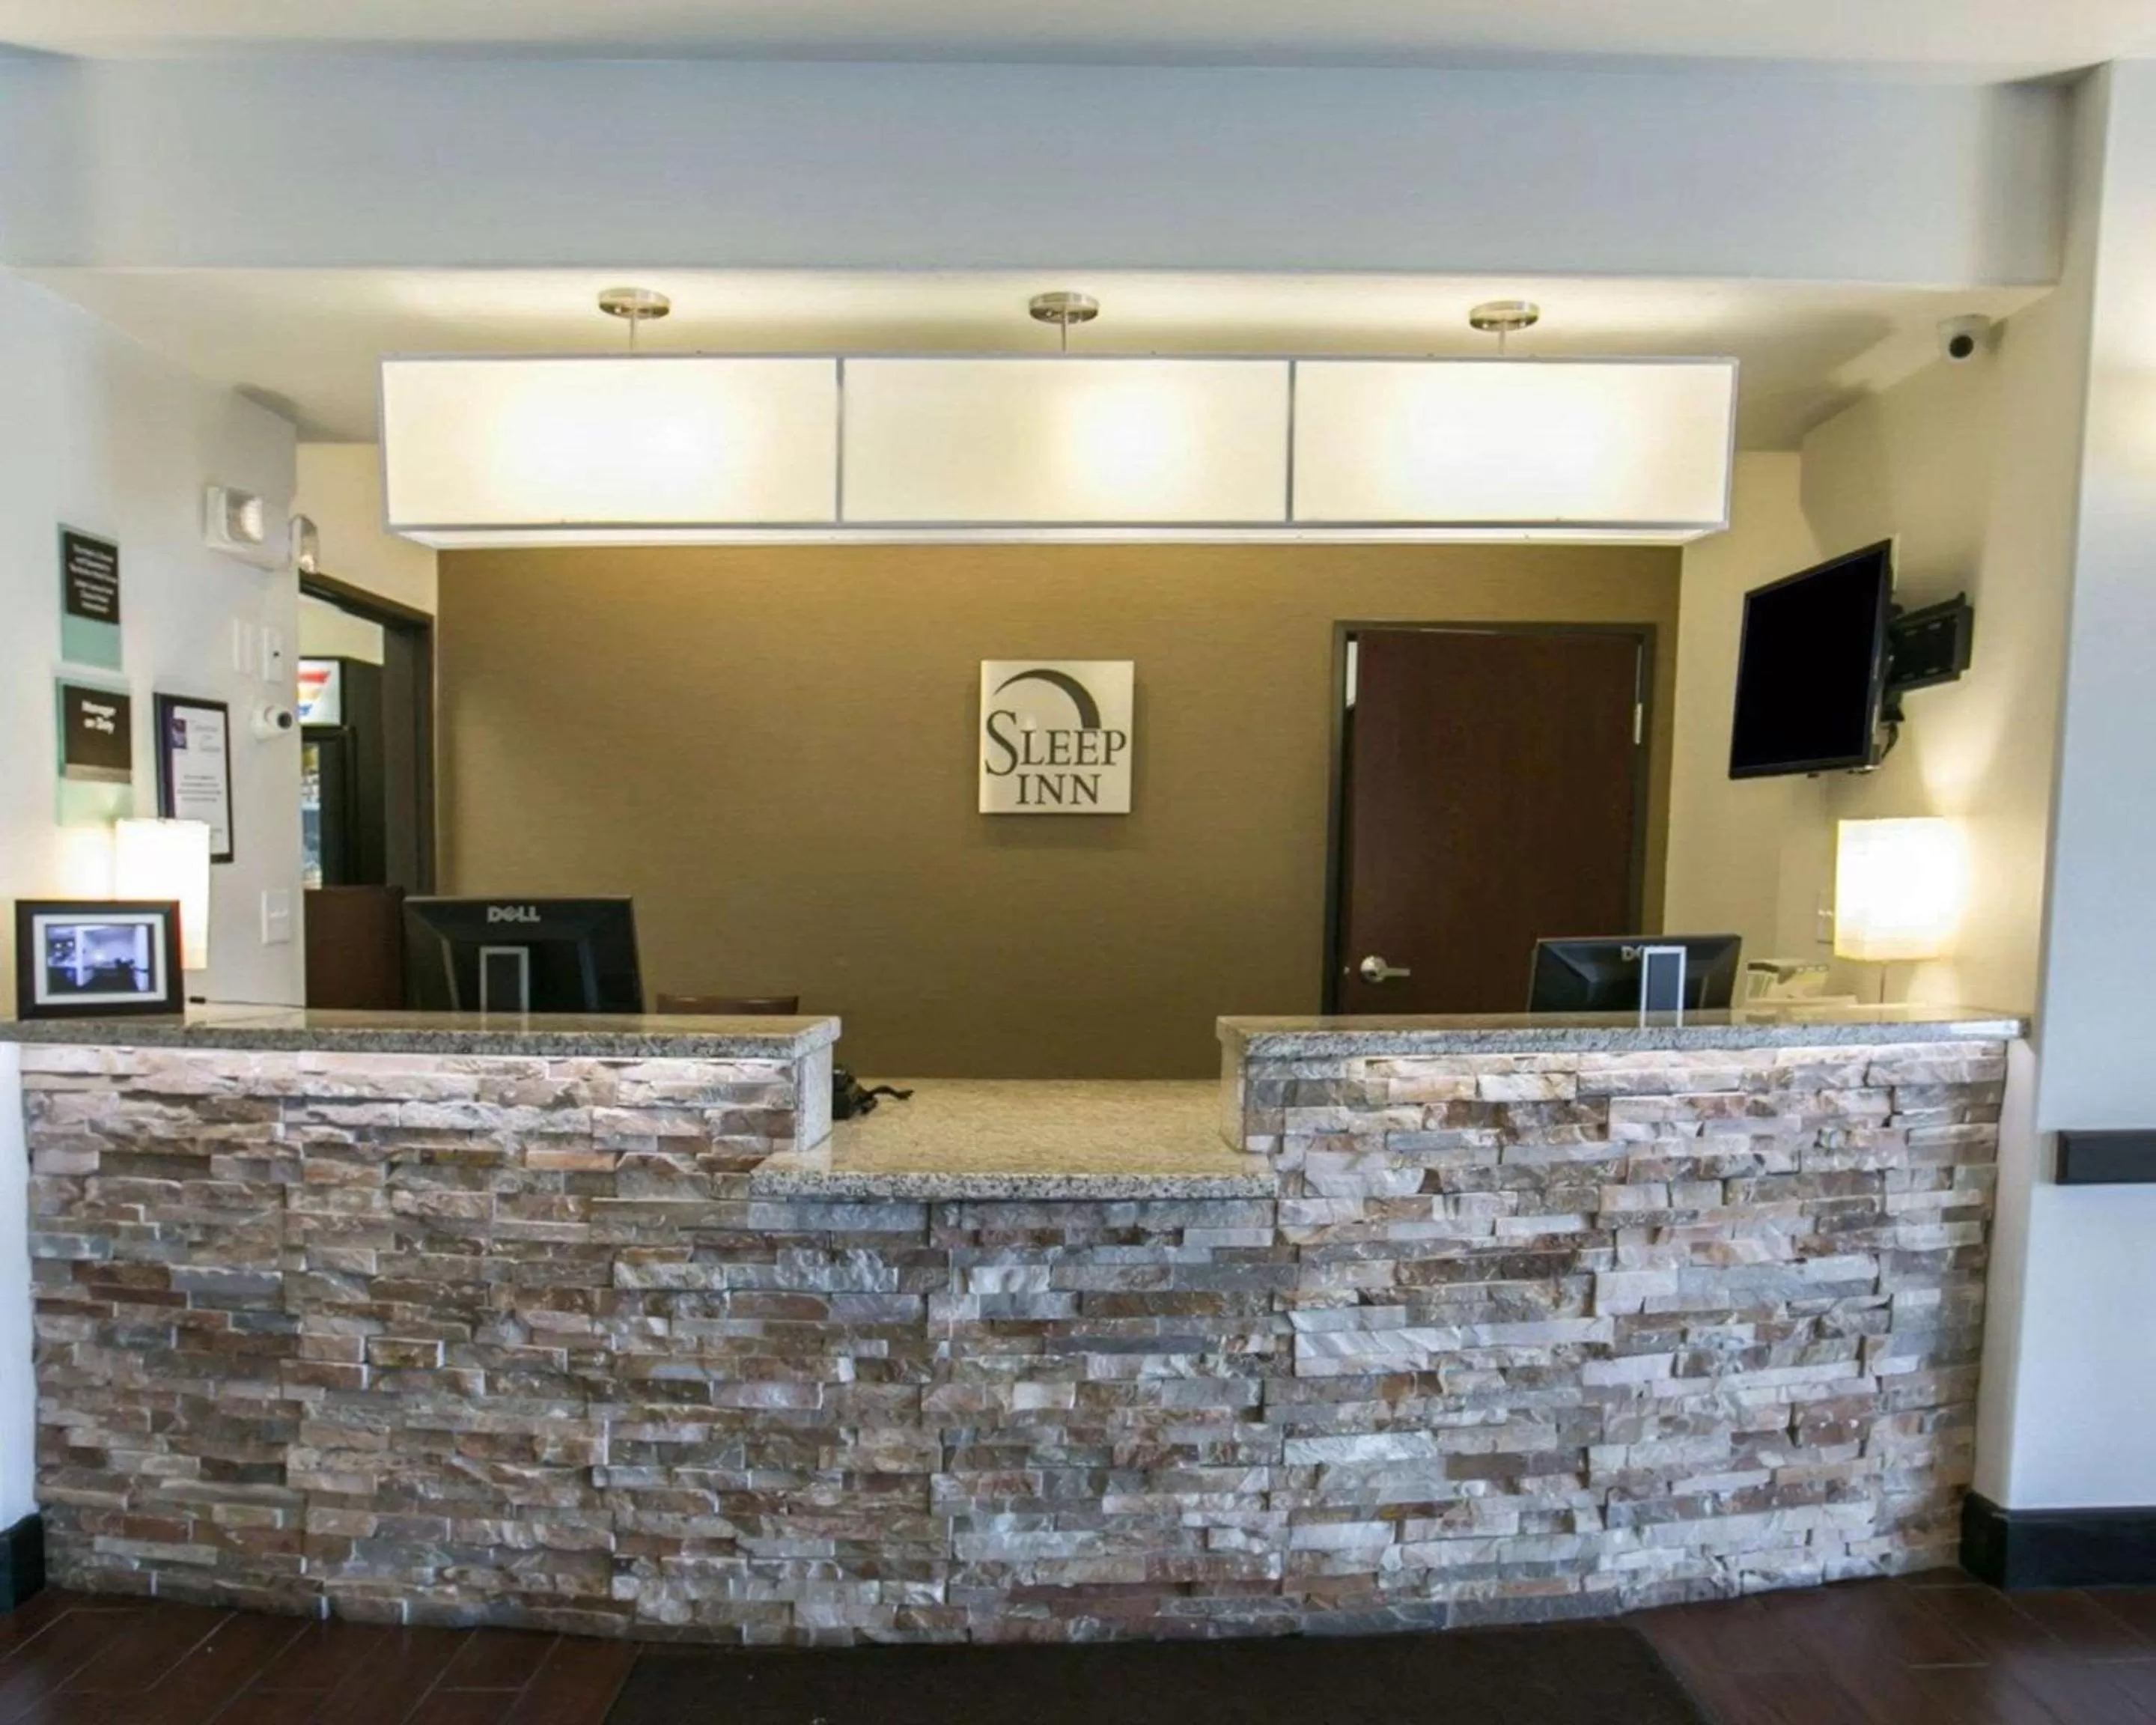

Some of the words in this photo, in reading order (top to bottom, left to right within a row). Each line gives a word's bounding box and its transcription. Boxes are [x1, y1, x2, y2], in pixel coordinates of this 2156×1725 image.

[984, 710, 1127, 776] SLEEP
[1015, 773, 1102, 805] INN
[487, 905, 541, 922] DELL
